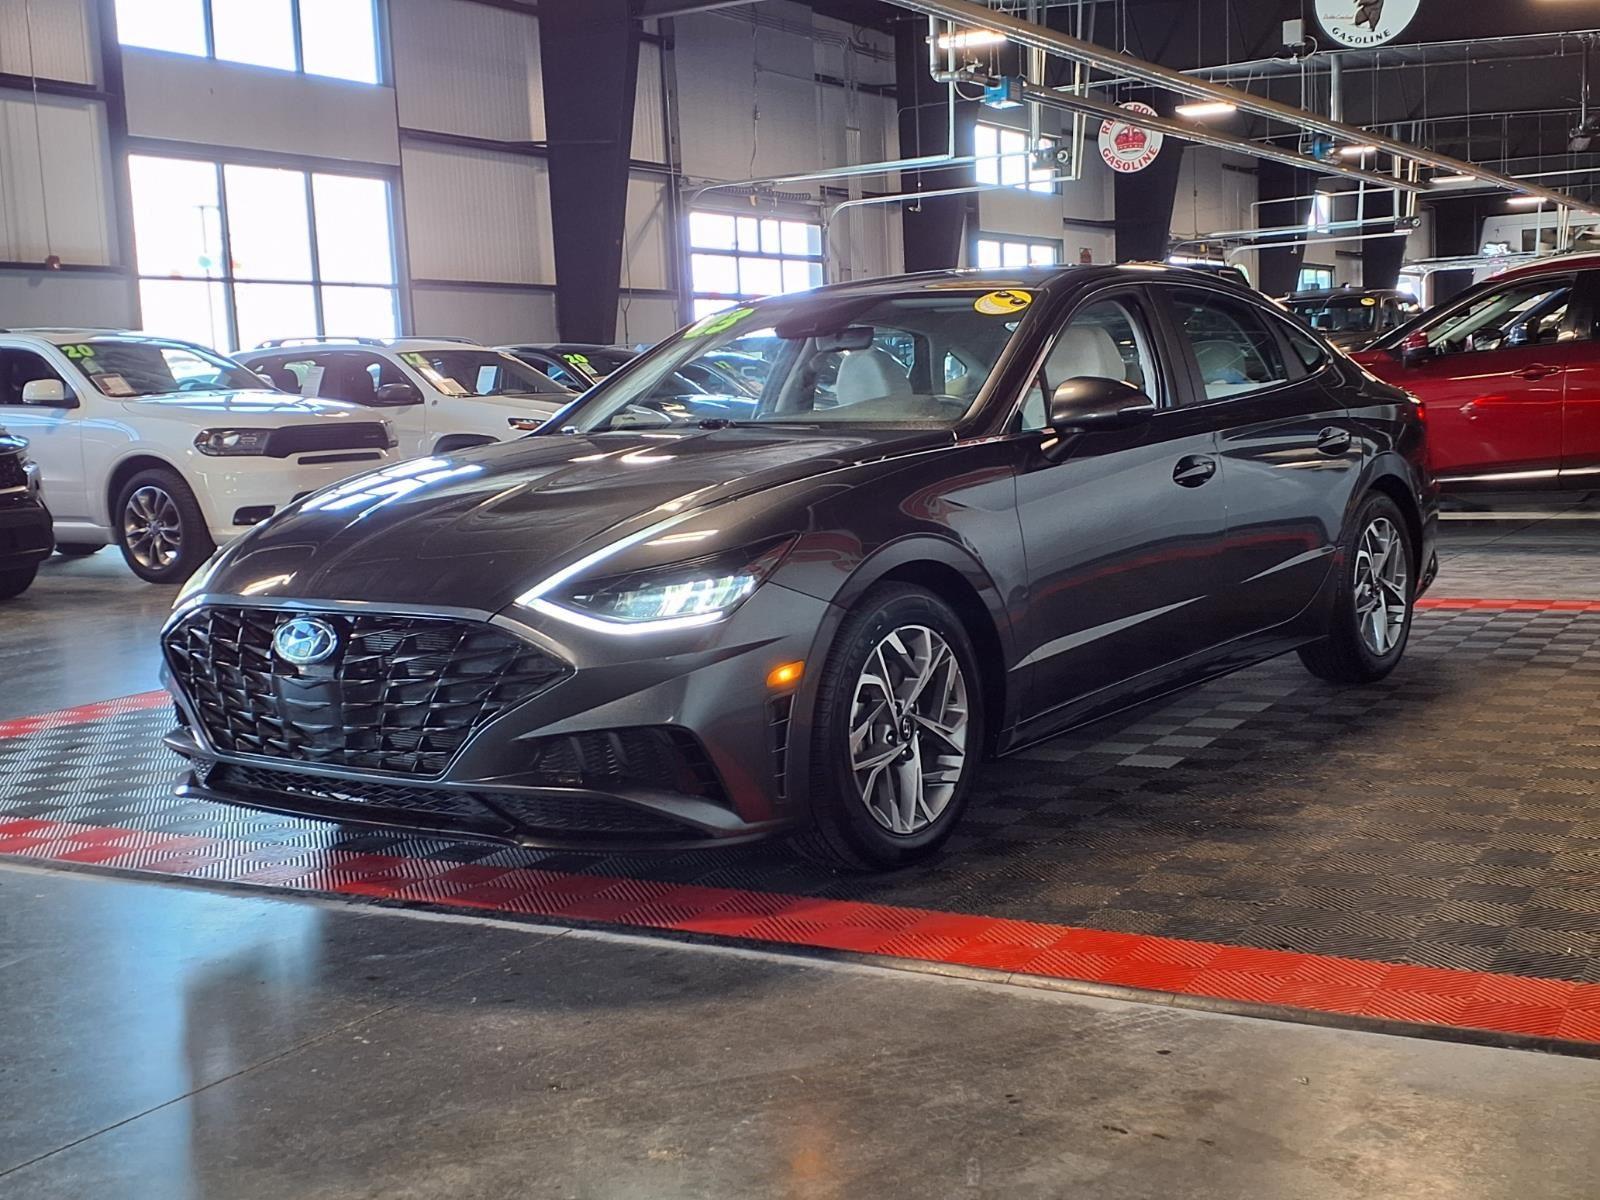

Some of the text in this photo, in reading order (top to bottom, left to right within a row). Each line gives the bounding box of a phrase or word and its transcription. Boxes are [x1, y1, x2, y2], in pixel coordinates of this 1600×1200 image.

[1332, 27, 1391, 43] GASOLINE
[1102, 145, 1158, 170] GASOLINE
[61, 344, 95, 358] 20
[562, 353, 589, 364] 20
